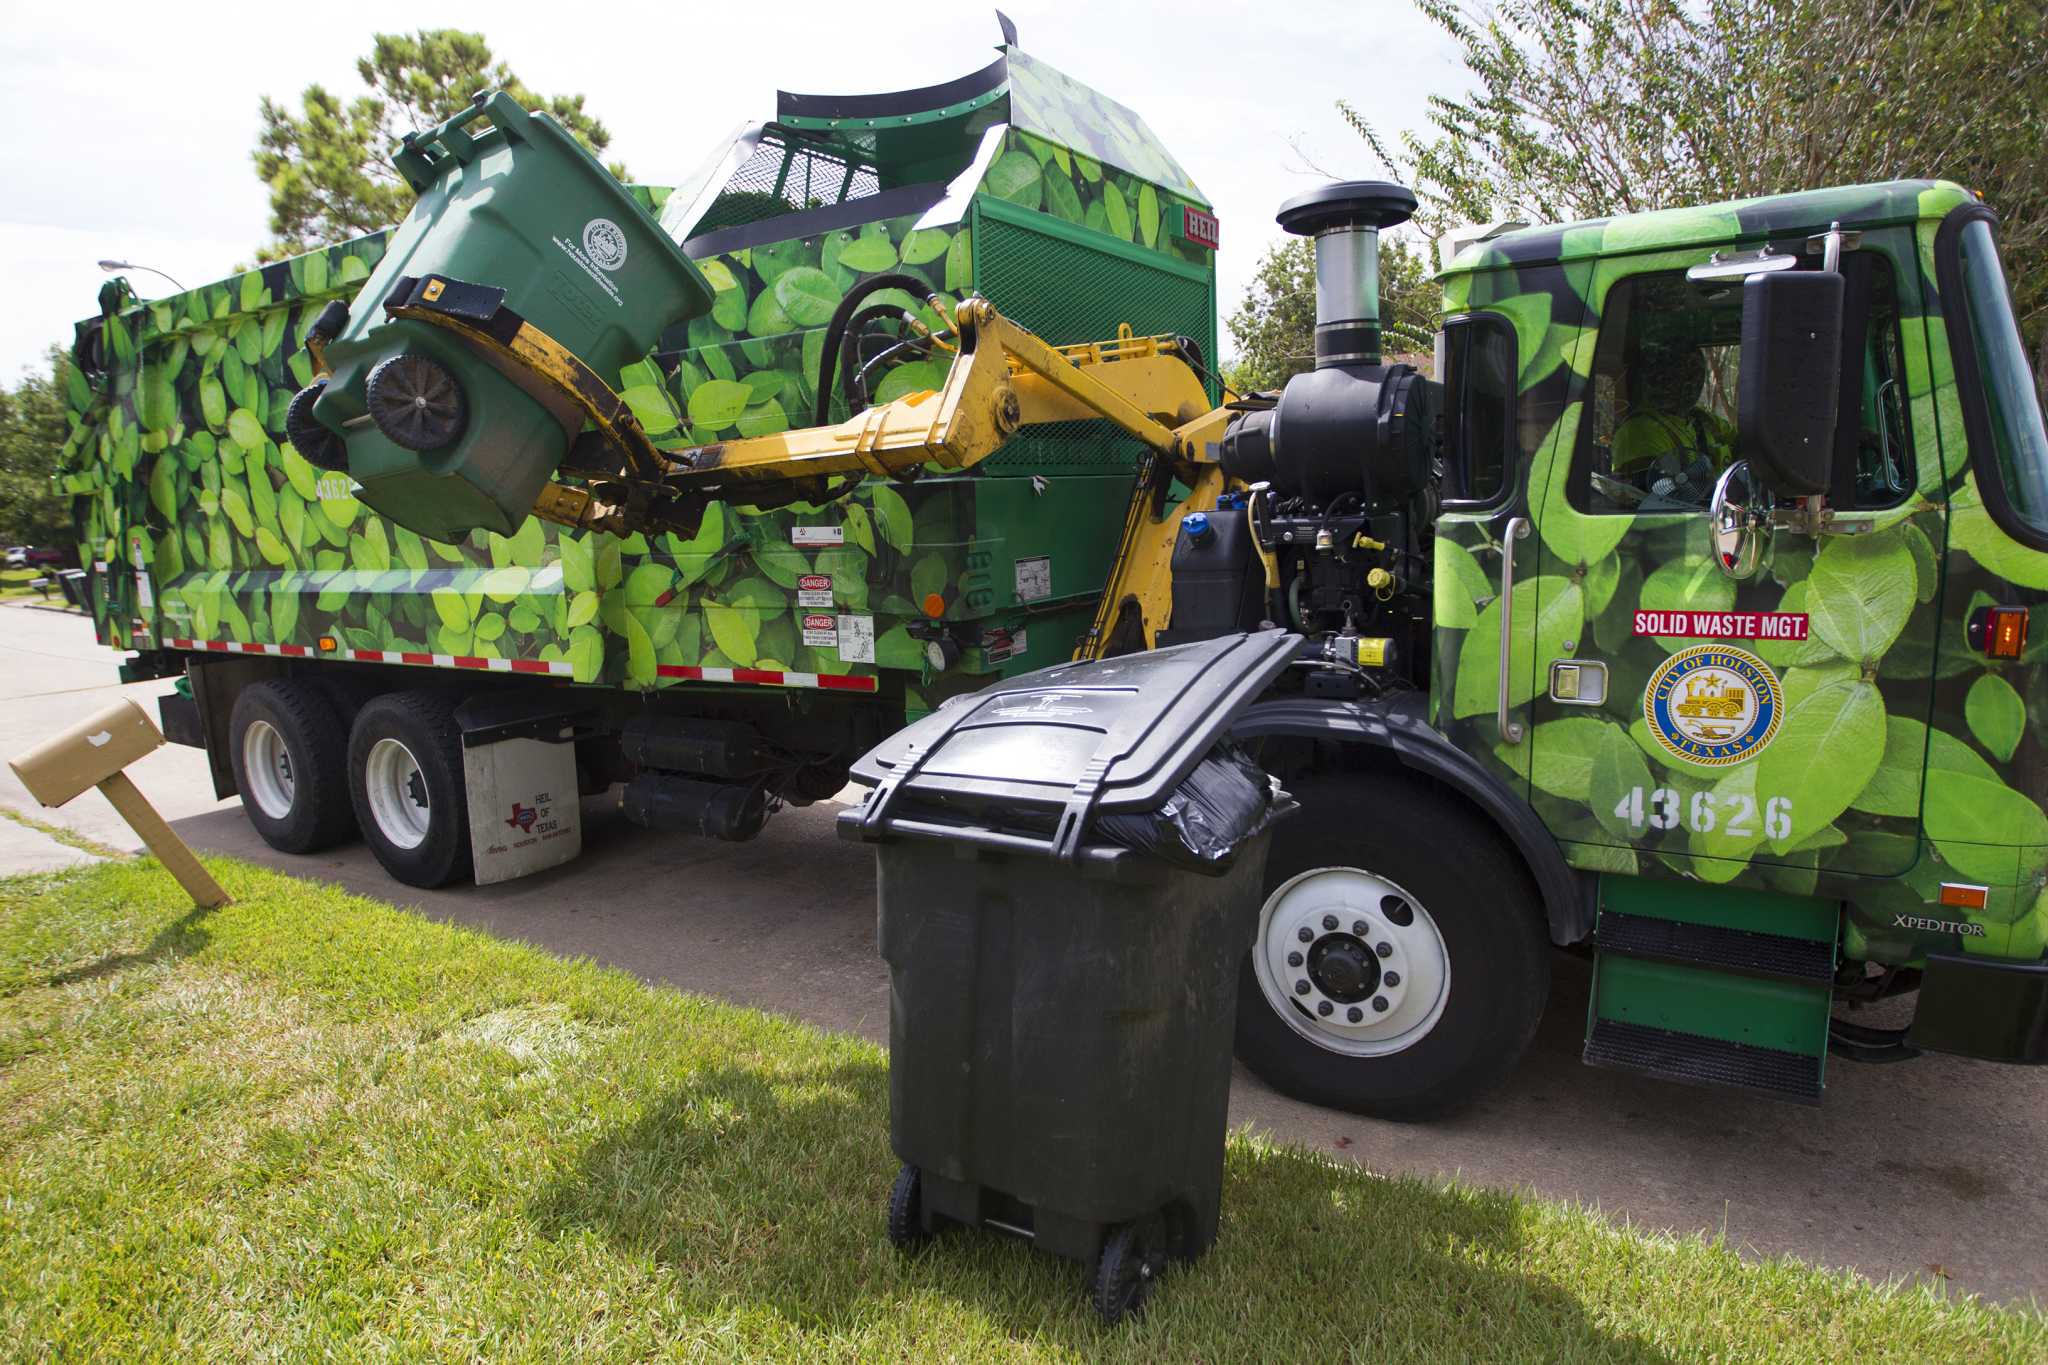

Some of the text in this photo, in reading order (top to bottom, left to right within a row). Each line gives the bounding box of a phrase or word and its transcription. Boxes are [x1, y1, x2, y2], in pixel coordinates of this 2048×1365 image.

[1188, 212, 1218, 243] HEIL
[316, 479, 352, 500] 4362
[801, 578, 829, 588] DANGER
[806, 618, 834, 628] DANGER
[1635, 613, 1808, 639] SOLID WASTE MGT.
[1656, 654, 1773, 705] CITY OF HOUSTON
[1678, 736, 1744, 757] TEXAS
[535, 792, 552, 804] HEIL
[540, 807, 550, 818] OF
[1614, 786, 1793, 841] 43626
[536, 820, 558, 833] TEXAS
[1892, 913, 1985, 937] XPEDITOR
